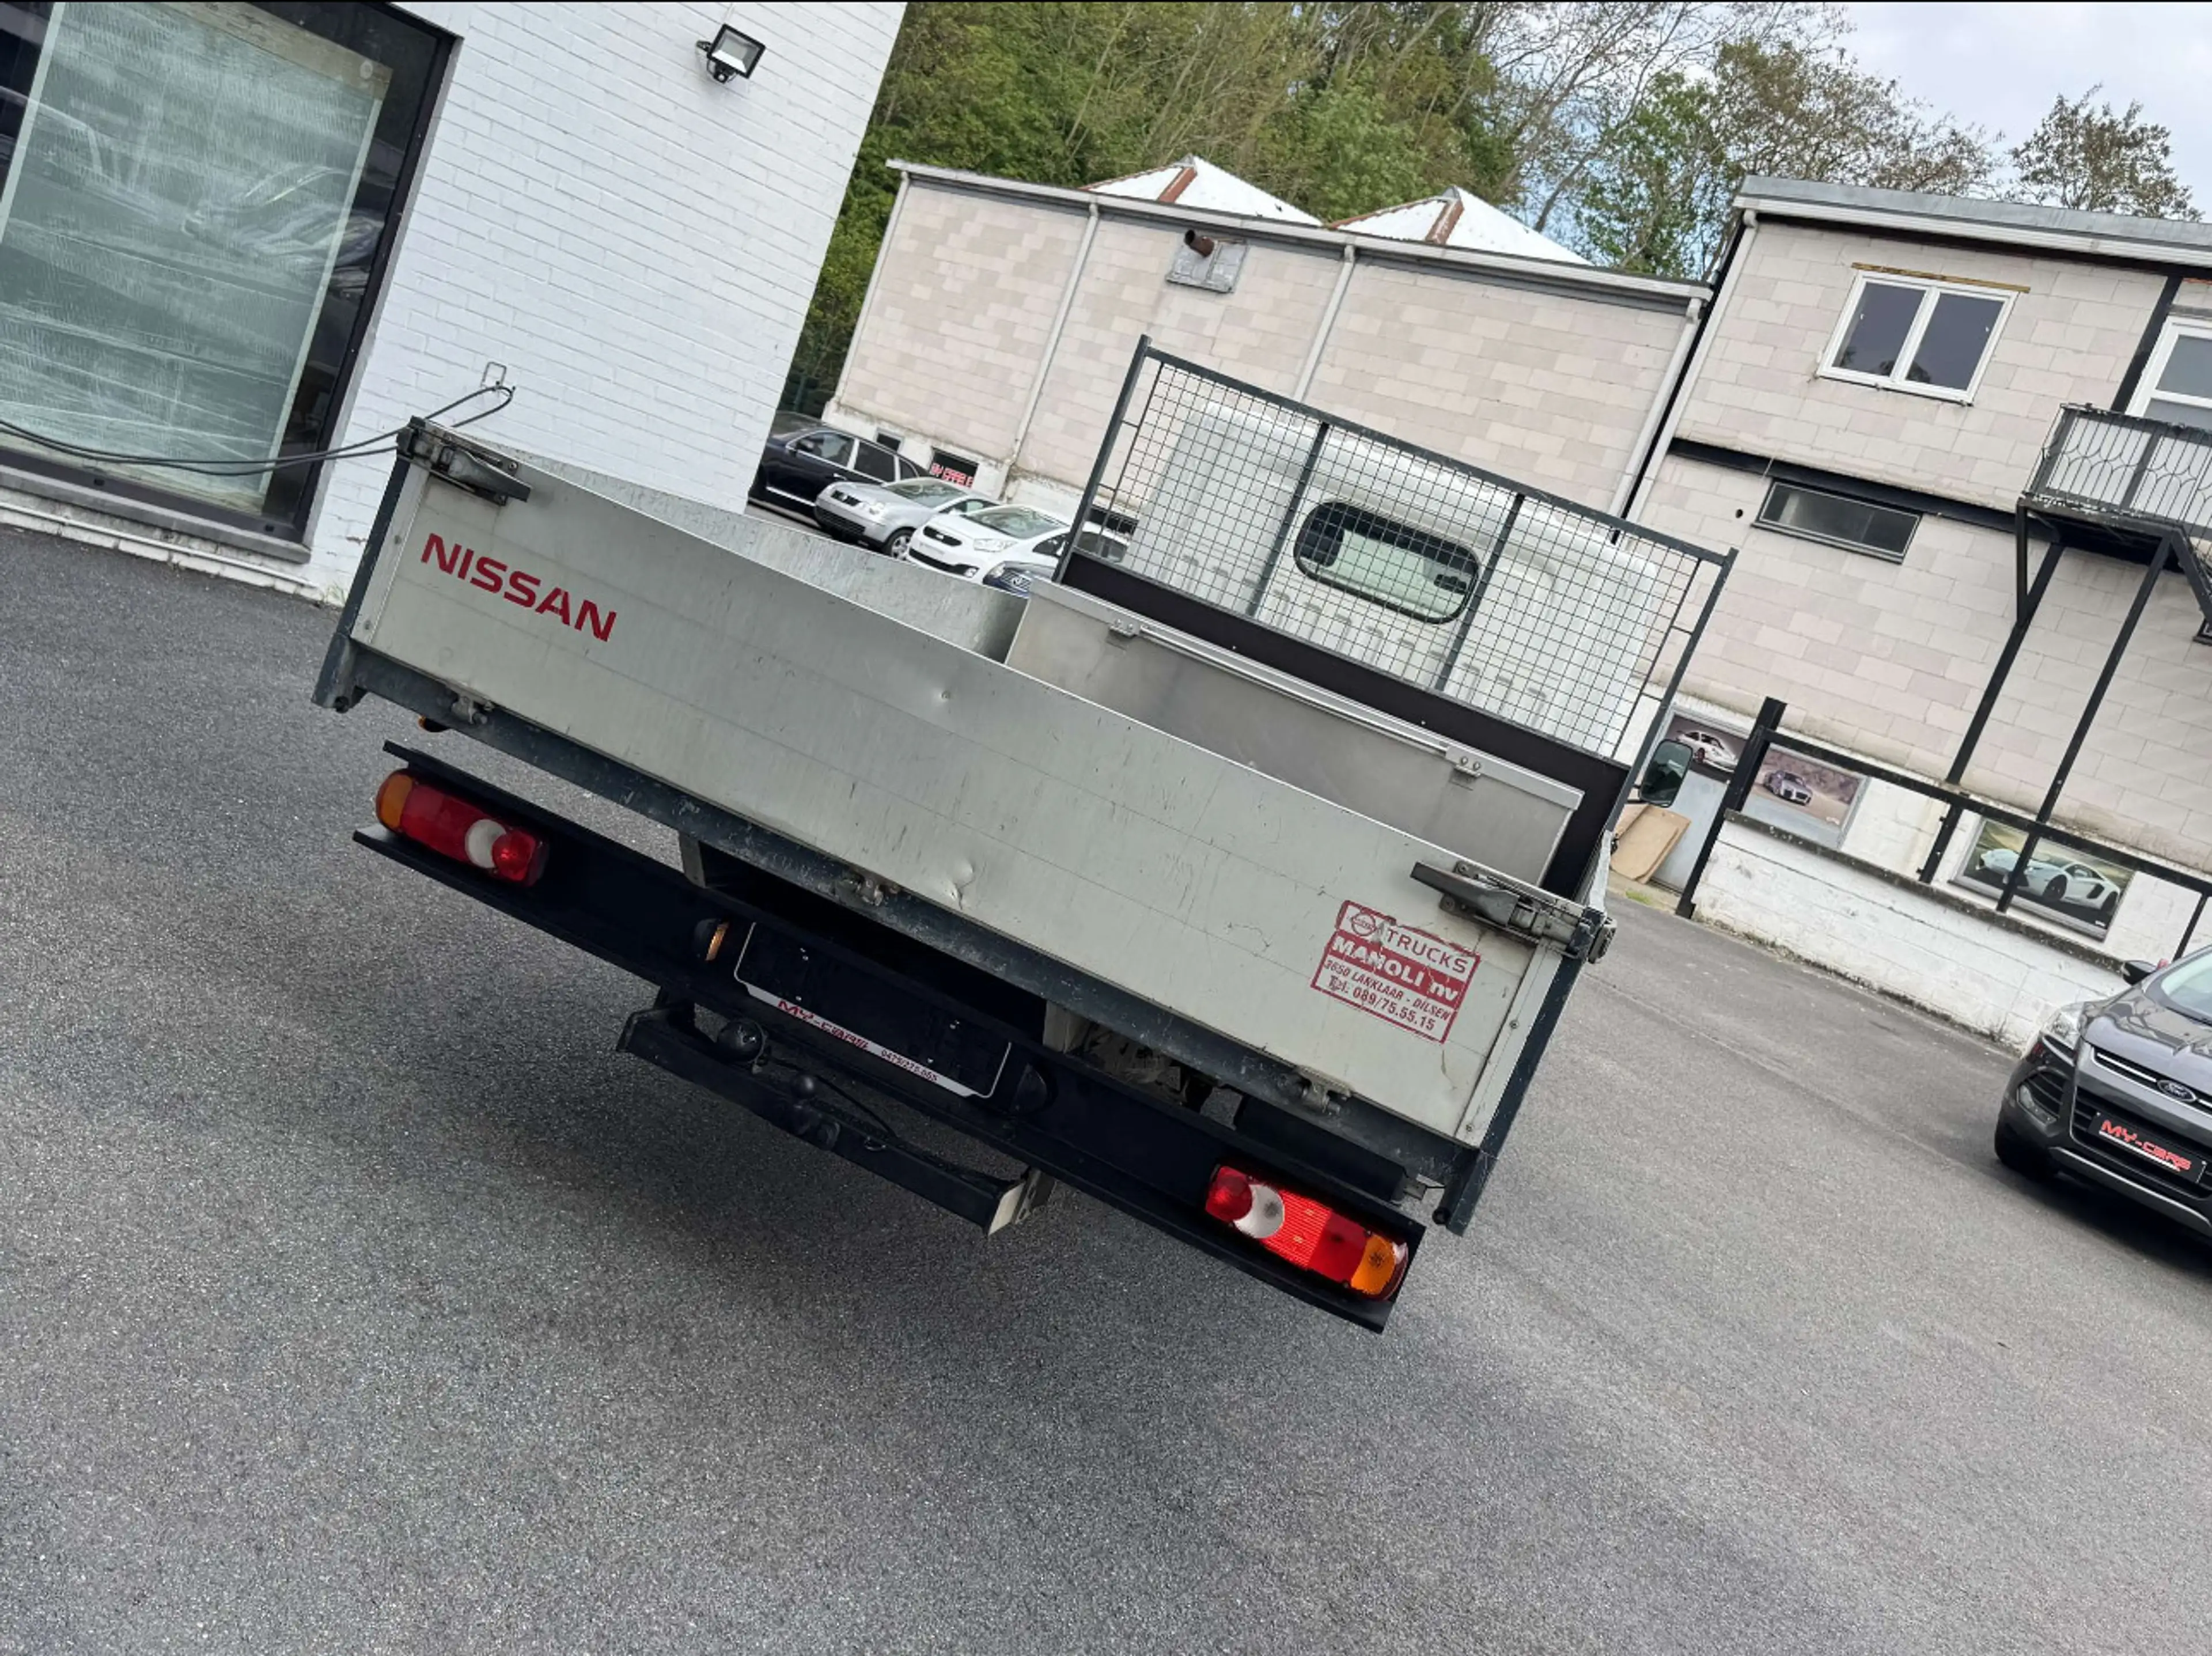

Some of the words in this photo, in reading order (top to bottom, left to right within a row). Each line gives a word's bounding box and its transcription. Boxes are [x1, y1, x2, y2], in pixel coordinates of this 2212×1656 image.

[421, 533, 617, 642] NISSAN
[1332, 937, 1425, 987] MANOLI
[1429, 982, 1459, 1001] nv
[1387, 929, 1468, 974] TRUCKS
[1353, 987, 1435, 1030] 089/75.55.15
[1412, 998, 1450, 1021] DILSEN
